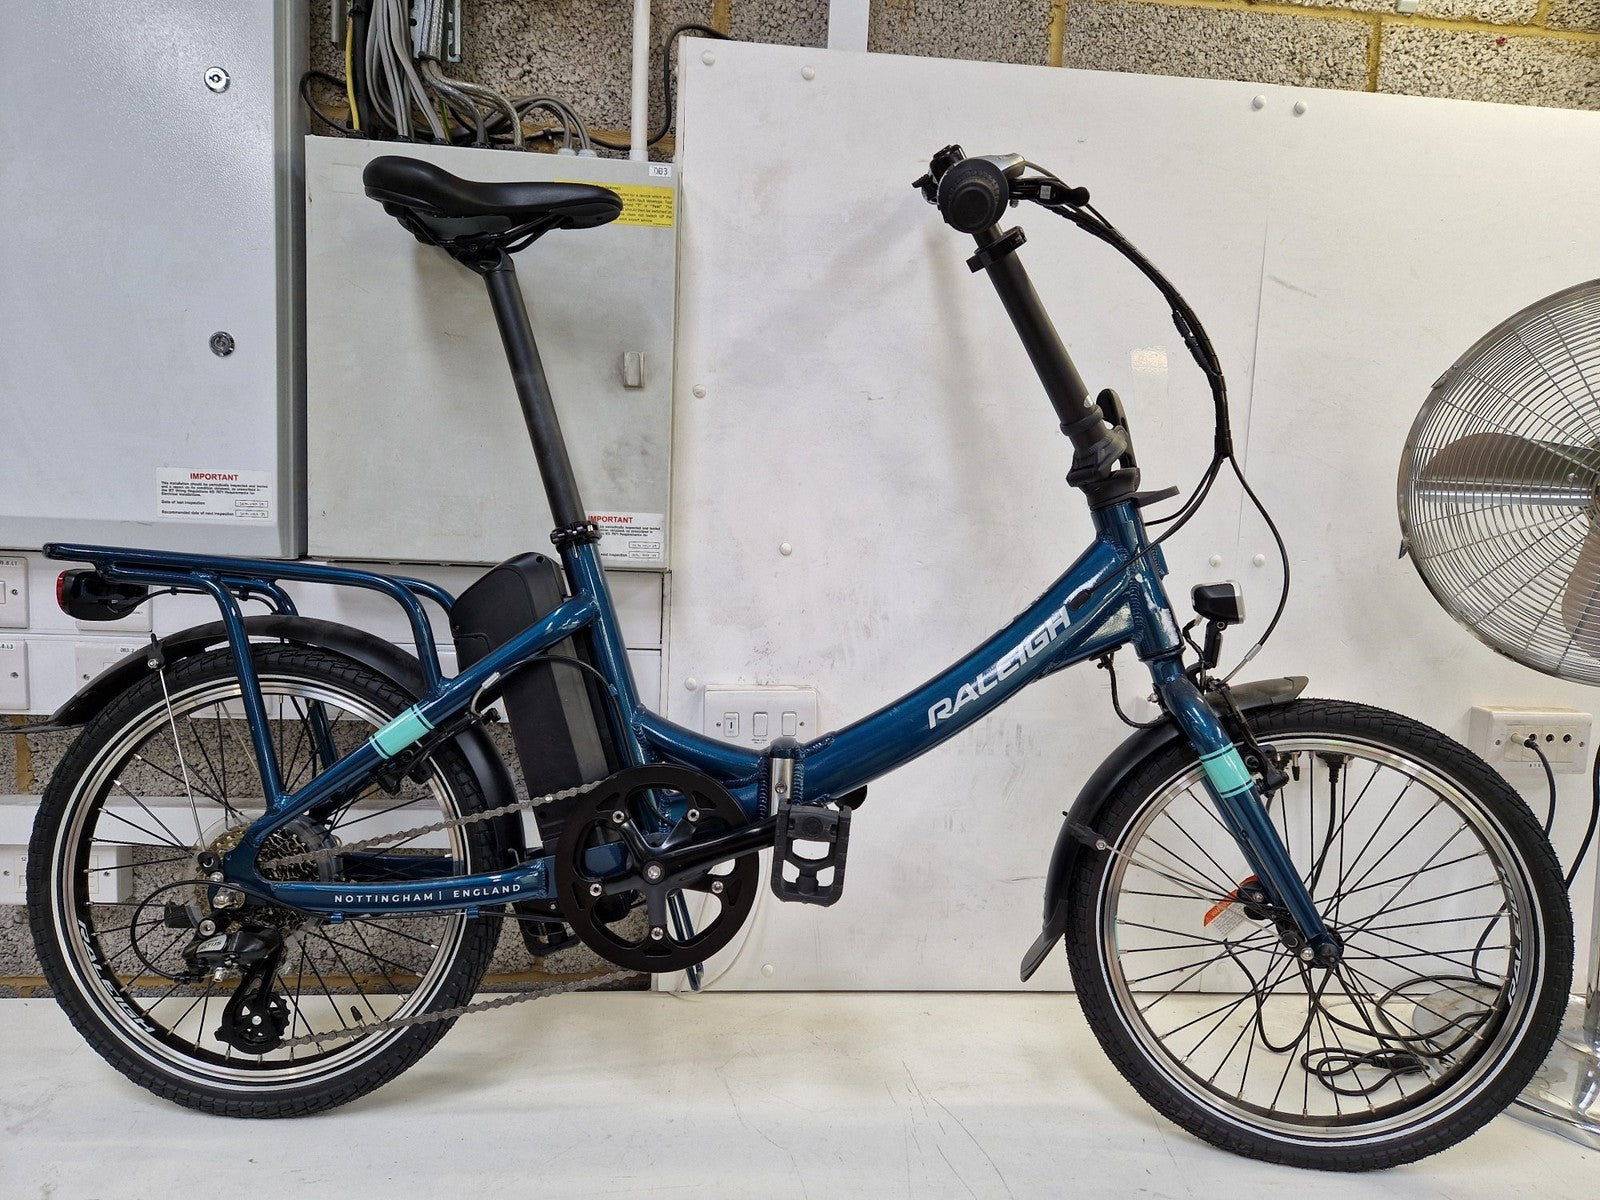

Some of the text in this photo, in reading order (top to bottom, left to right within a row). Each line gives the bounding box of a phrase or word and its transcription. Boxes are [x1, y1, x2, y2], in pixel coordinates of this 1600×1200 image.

[654, 167, 668, 175] DB3
[928, 606, 1070, 730] RALEIGH
[335, 884, 521, 903] NOTTINGHAM ENGLAND
[1498, 866, 1522, 1006] RALEIGH
[78, 919, 155, 1032] RALEIGH
